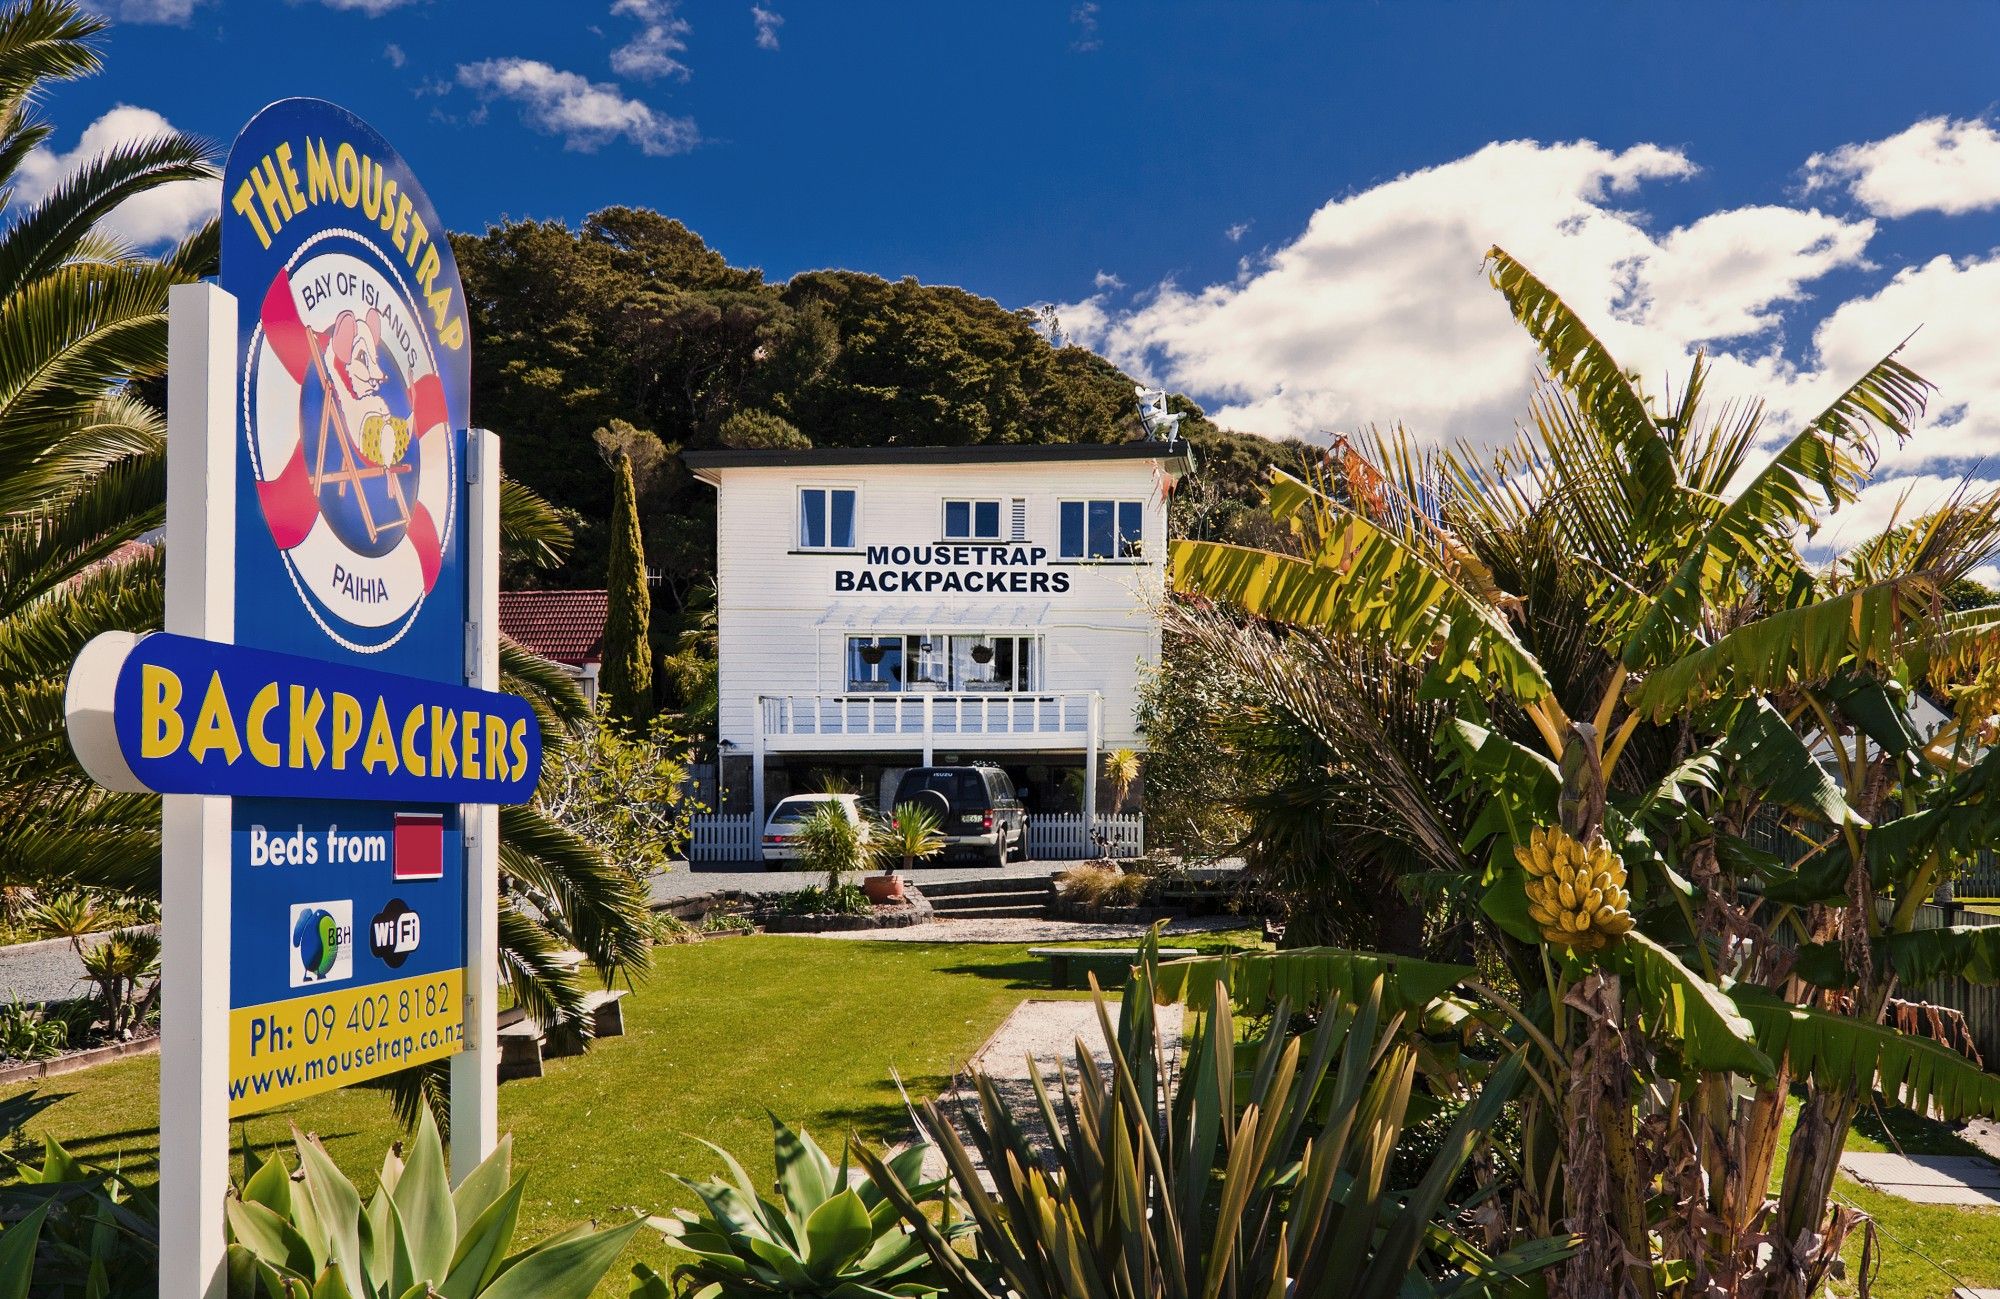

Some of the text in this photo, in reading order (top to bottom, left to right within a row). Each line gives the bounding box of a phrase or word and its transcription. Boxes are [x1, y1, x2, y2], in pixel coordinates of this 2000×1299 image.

[232, 135, 464, 351] THE MOUSETRAP
[302, 272, 418, 369] BAY OF ISLANDS
[332, 563, 389, 603] PAIHIA
[835, 571, 1070, 593] BACKPACKERS
[867, 546, 1047, 566] MOUSETRAP
[141, 663, 528, 783] BACKPACKERS
[250, 824, 386, 866] Beds from
[328, 926, 351, 946] BBH
[251, 981, 449, 1057] Ph: 09 402 8182
[229, 1022, 464, 1101] www.mousetrap.co.nz
